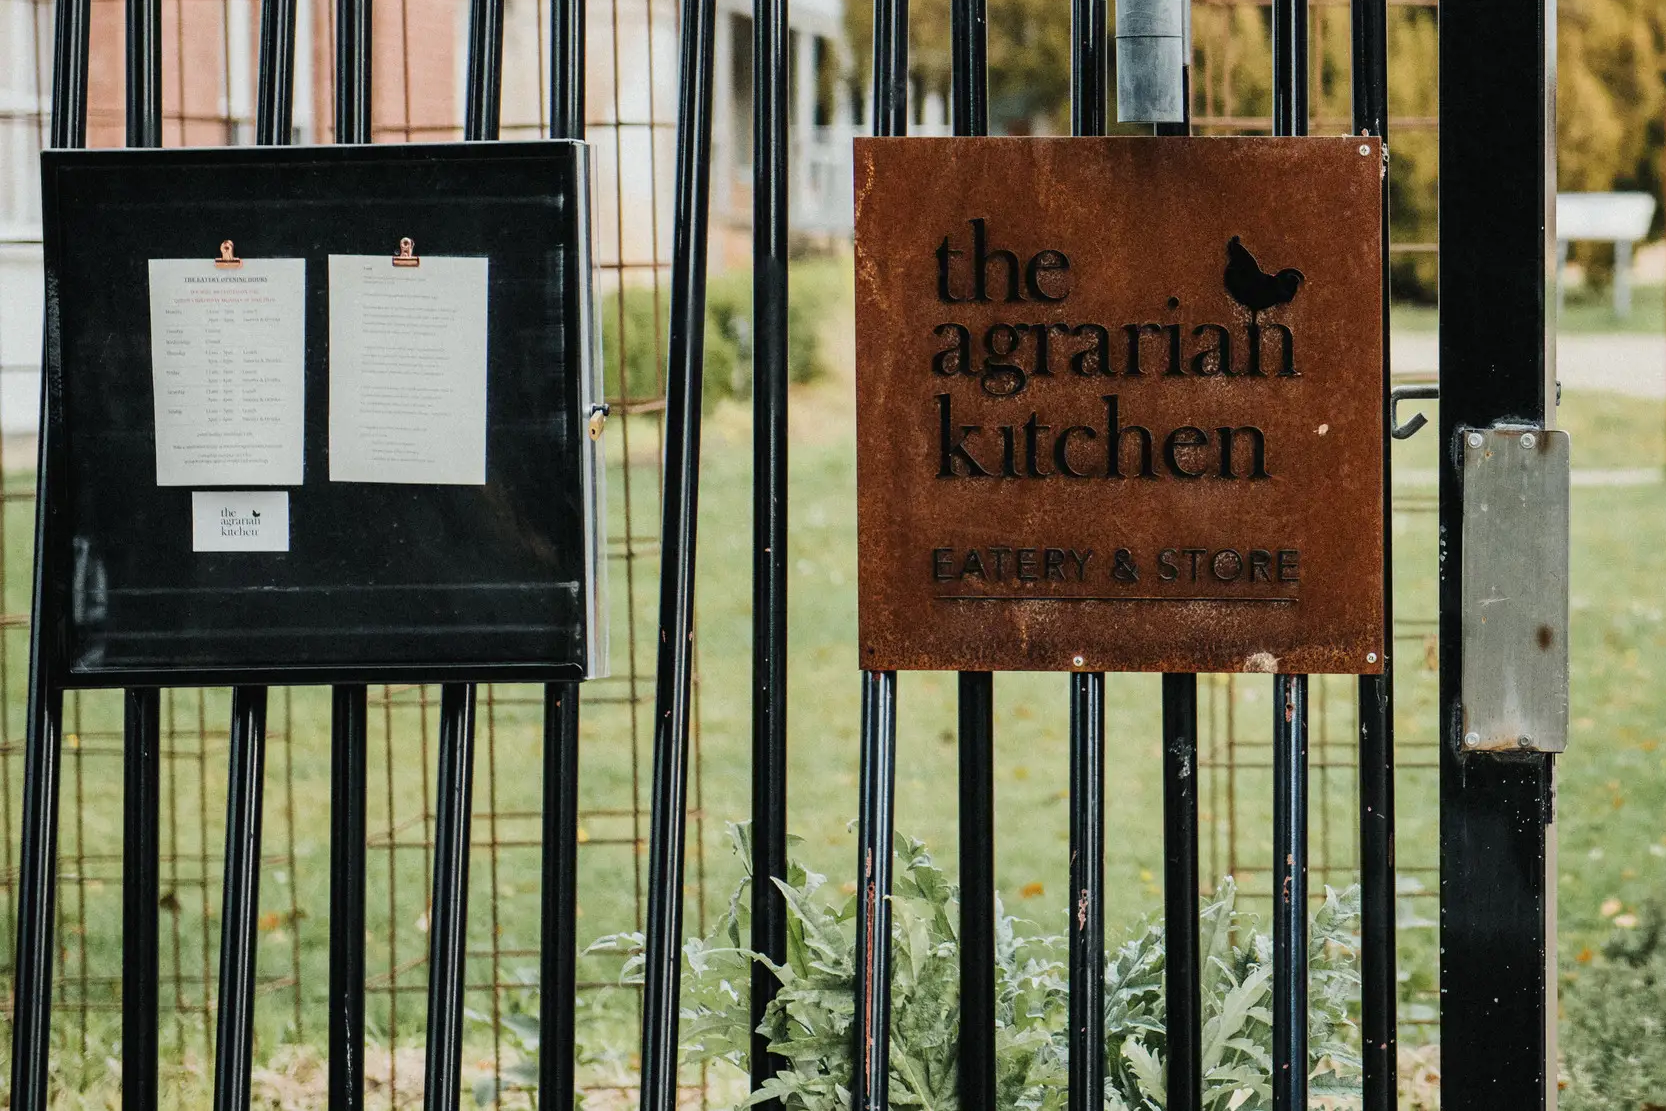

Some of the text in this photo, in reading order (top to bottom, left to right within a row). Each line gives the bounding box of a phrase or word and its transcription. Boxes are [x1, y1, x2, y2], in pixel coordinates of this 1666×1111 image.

[934, 217, 1072, 305] the
[931, 295, 1302, 397] agrarian
[934, 393, 1273, 483] kitchen
[221, 507, 236, 517] the
[221, 517, 260, 526] agrarian
[221, 526, 258, 536] kitchen
[933, 547, 1301, 583] EATERY & STORE
